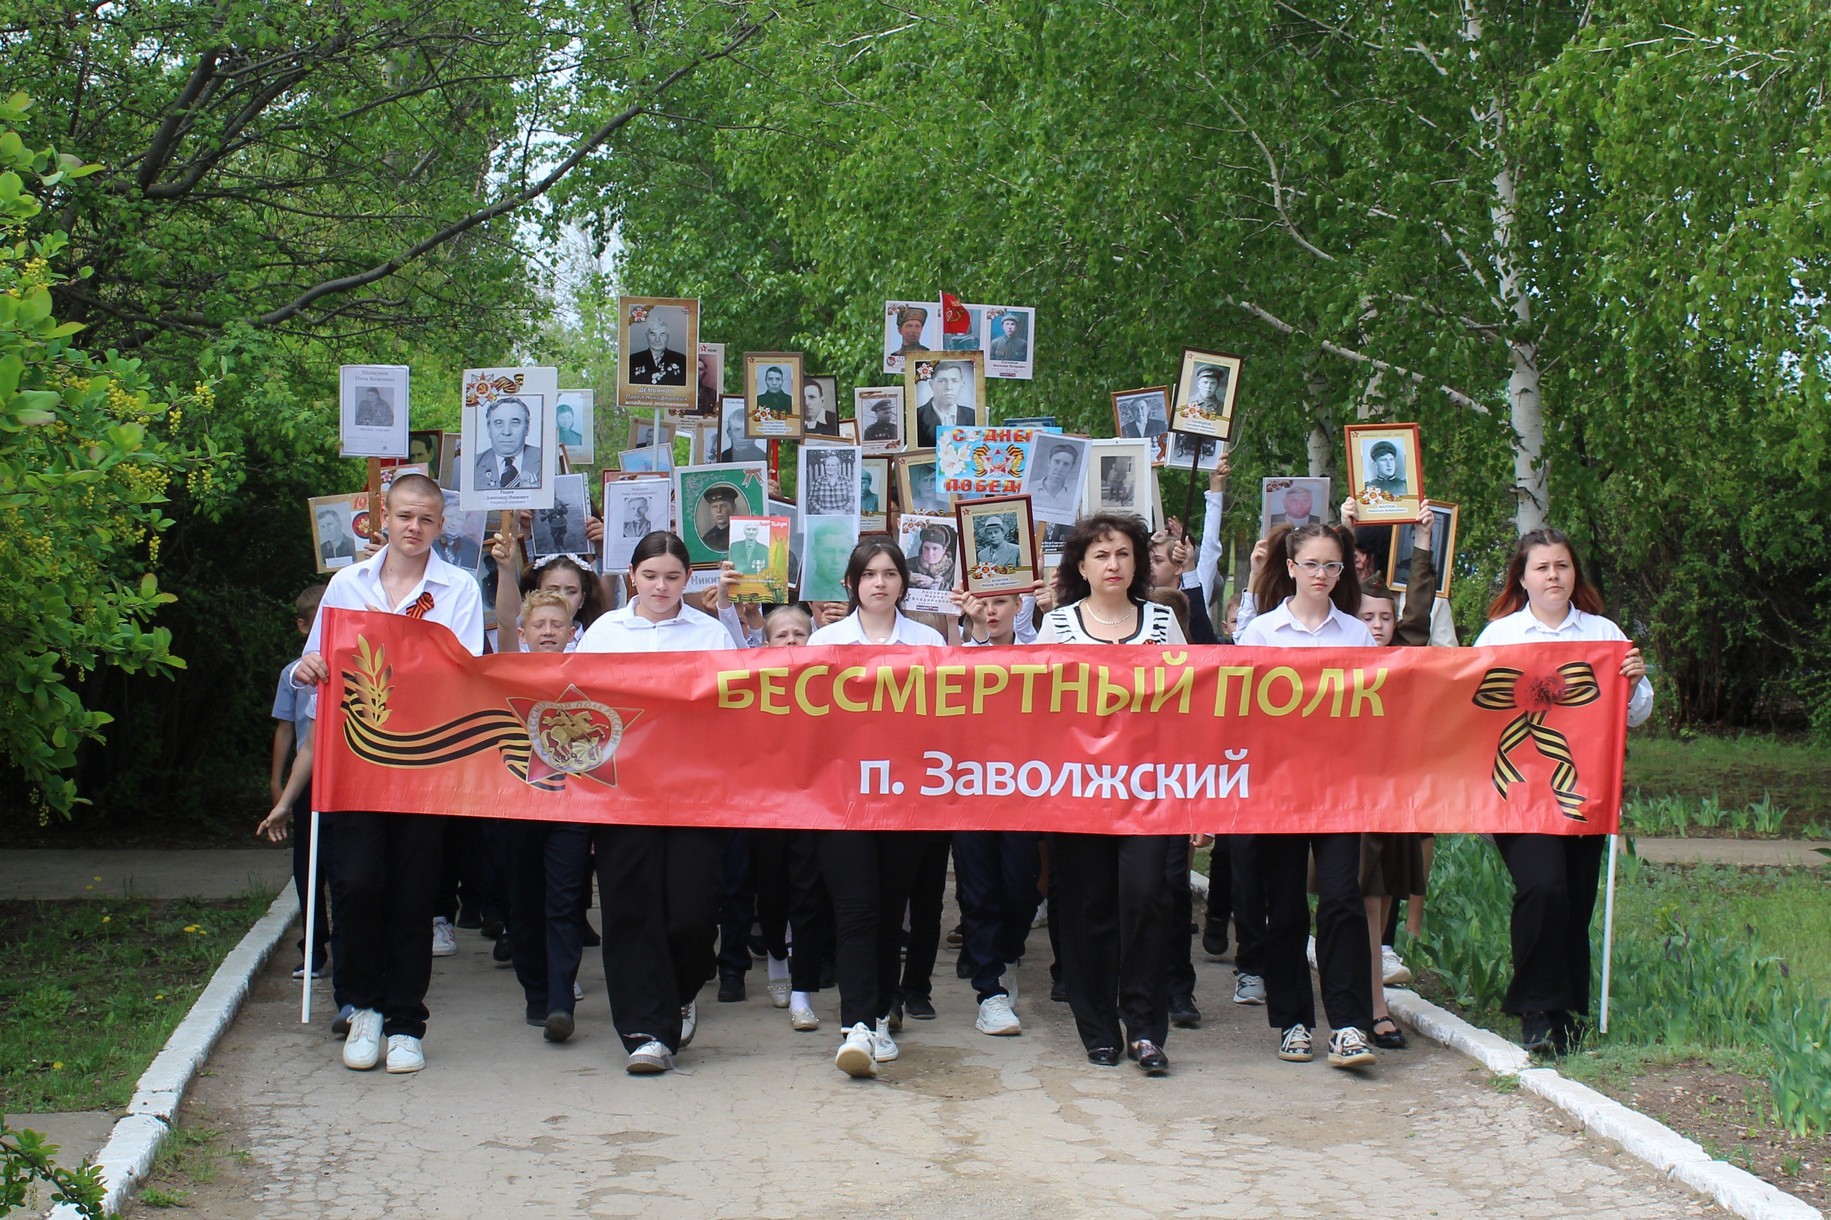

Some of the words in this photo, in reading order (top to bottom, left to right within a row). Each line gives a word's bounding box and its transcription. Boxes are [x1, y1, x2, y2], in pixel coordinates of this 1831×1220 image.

[952, 428, 966, 442] С
[691, 575, 720, 585] Никит
[716, 651, 1195, 718] БЕССМЕРТНЫЙ
[1213, 665, 1389, 718] ПОЛК
[859, 759, 905, 796] п.
[919, 748, 1250, 799] Заволжский
